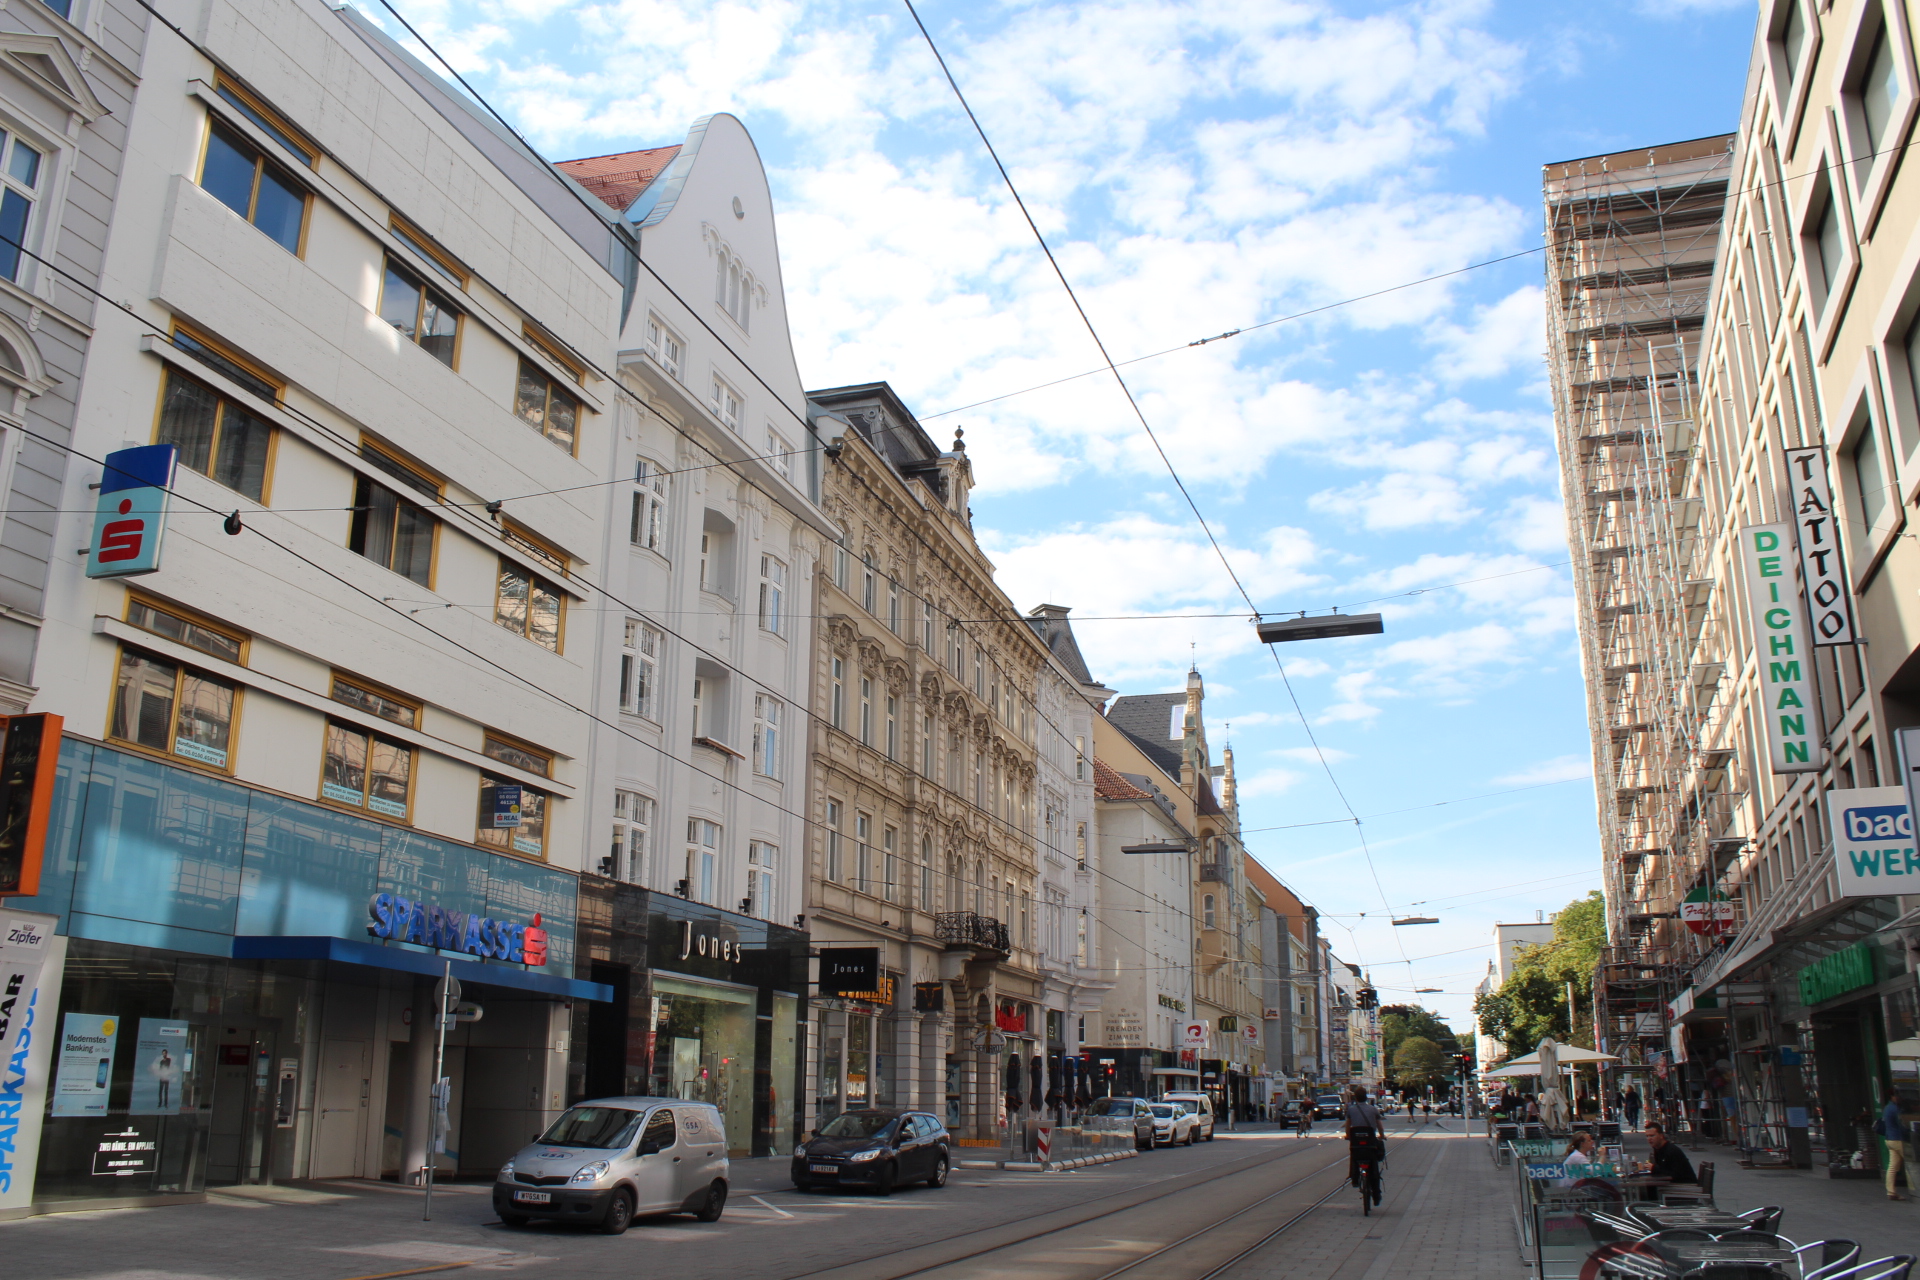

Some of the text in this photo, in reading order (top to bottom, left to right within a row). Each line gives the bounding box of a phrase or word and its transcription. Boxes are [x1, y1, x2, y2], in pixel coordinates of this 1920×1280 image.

[1794, 453, 1844, 639] TATTOO
[1753, 531, 1809, 764] DEICHMANN
[1848, 811, 1912, 838] bac
[1848, 848, 1920, 878] WER
[366, 892, 525, 963] SPARKASSE
[7, 929, 41, 945] Zipfer
[677, 920, 741, 964] Jones
[832, 963, 864, 974] Jones
[66, 1034, 107, 1044] Modernstes
[65, 1043, 94, 1054] Banking
[685, 1121, 699, 1130] GSA
[99, 1142, 111, 1152] ZWEI
[127, 1142, 136, 1151] EIN
[136, 1141, 155, 1151] APPLAUS.
[540, 1151, 565, 1159] GSA
[1526, 1163, 1618, 1179] back WERK
